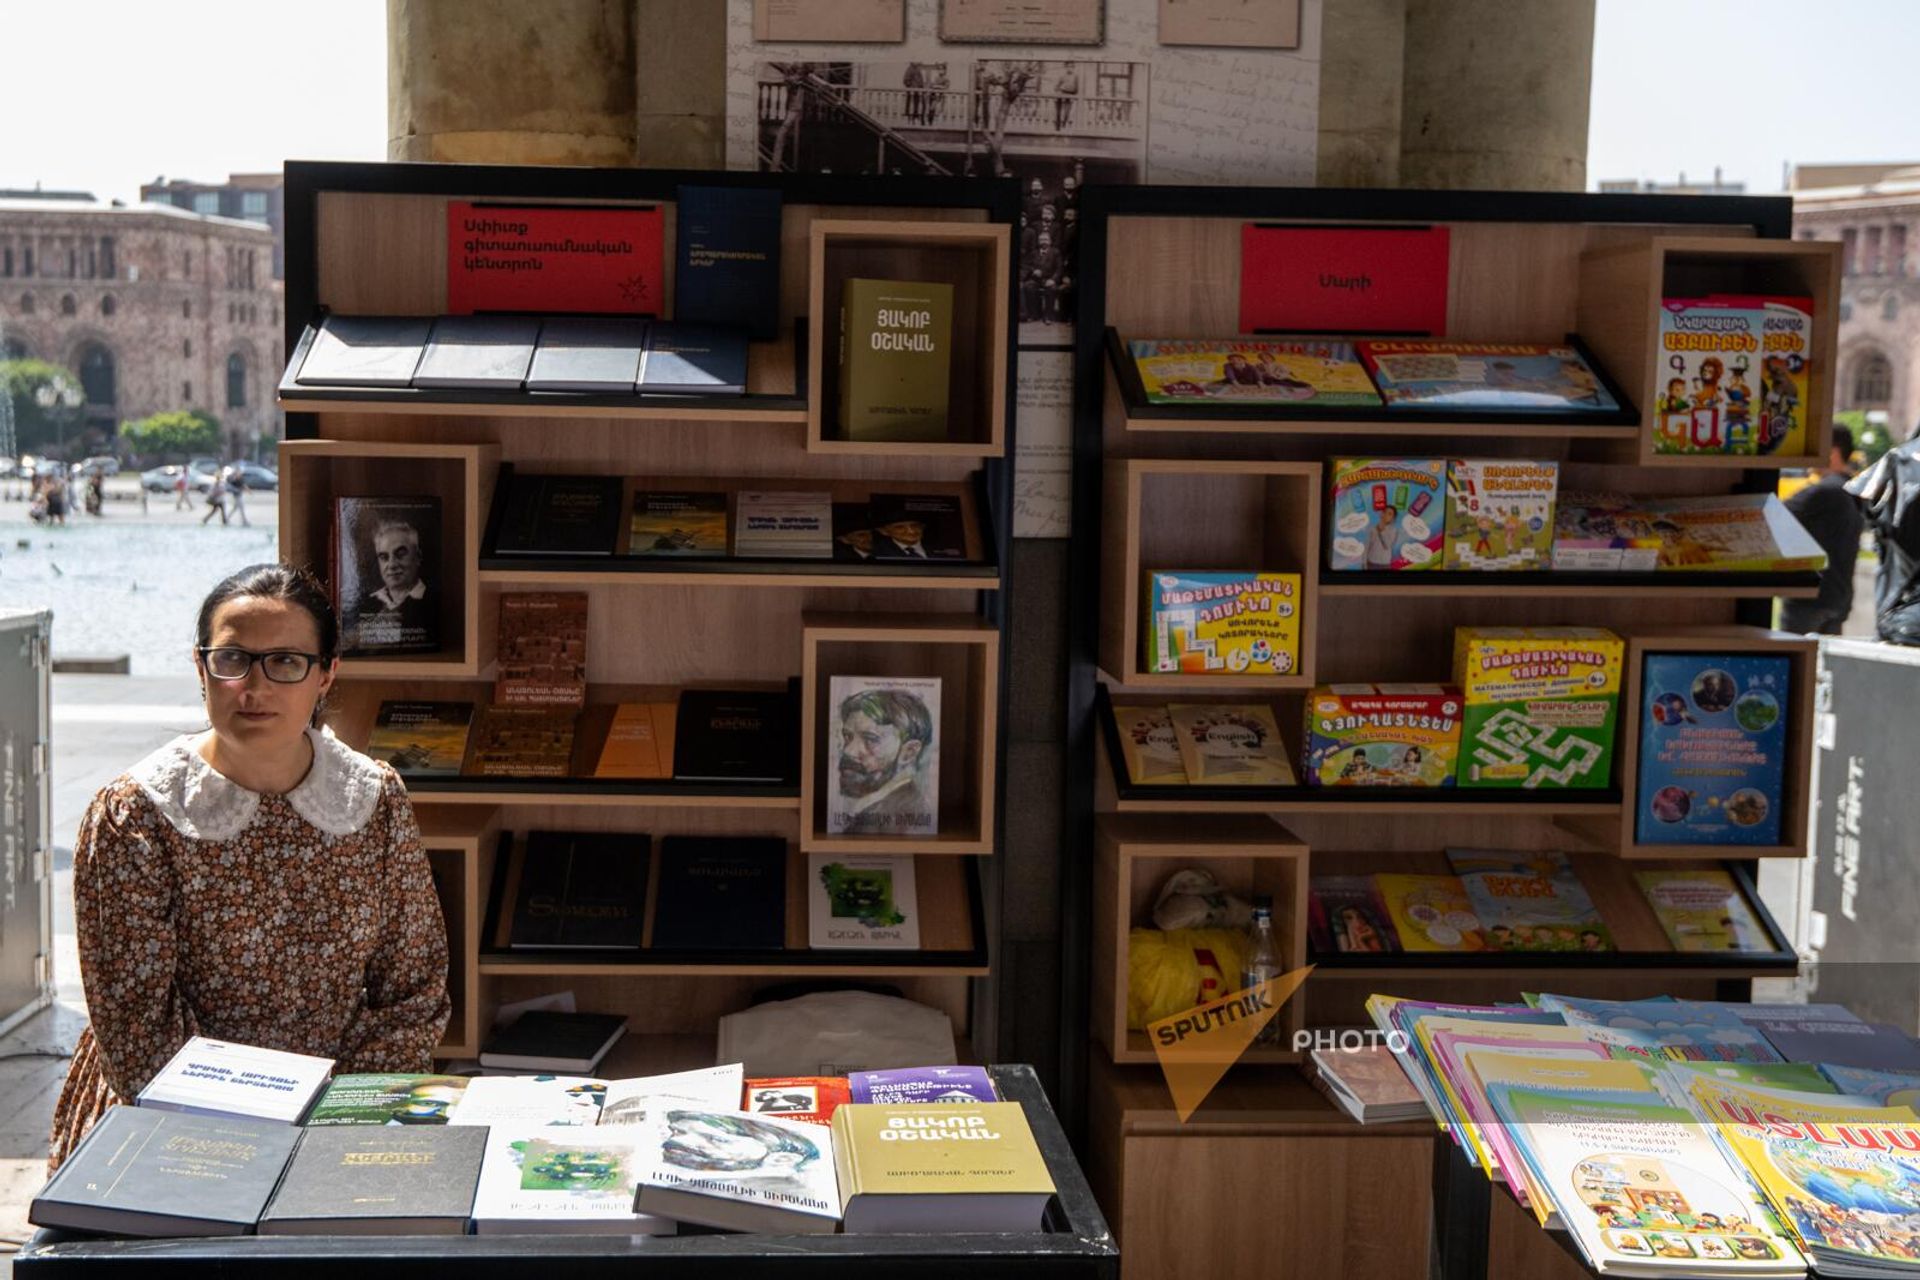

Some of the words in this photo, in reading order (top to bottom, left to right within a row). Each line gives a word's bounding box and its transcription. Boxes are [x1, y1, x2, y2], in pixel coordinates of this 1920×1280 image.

[464, 257, 543, 272] կենտրոն
[1319, 273, 1372, 292] Մարի
[877, 308, 930, 329] ՅԱԿՈԲ
[870, 332, 934, 352] ՕՇԱԿԱՆ
[1664, 332, 1758, 353] ԱՅԲՈՒԲԵՆ
[1161, 580, 1293, 605] ՄԱԹԵՄԱՏԻԿԱԿԱՆ
[1200, 597, 1271, 624] ԴՈՄԻՆՈ
[1482, 651, 1606, 671] ՄԱԹԵՄԱՏԻԿԱԿԱՆ
[1511, 663, 1569, 680] ԴՈՄԻՆՈ
[1320, 712, 1455, 733] ԳՅՈՒՂԱՏՆՏԵՍ
[1208, 731, 1256, 746] English
[889, 1116, 987, 1129] ՅԱԿՈԲ
[879, 1128, 1002, 1142] ՕՇԱԿԱՆ
